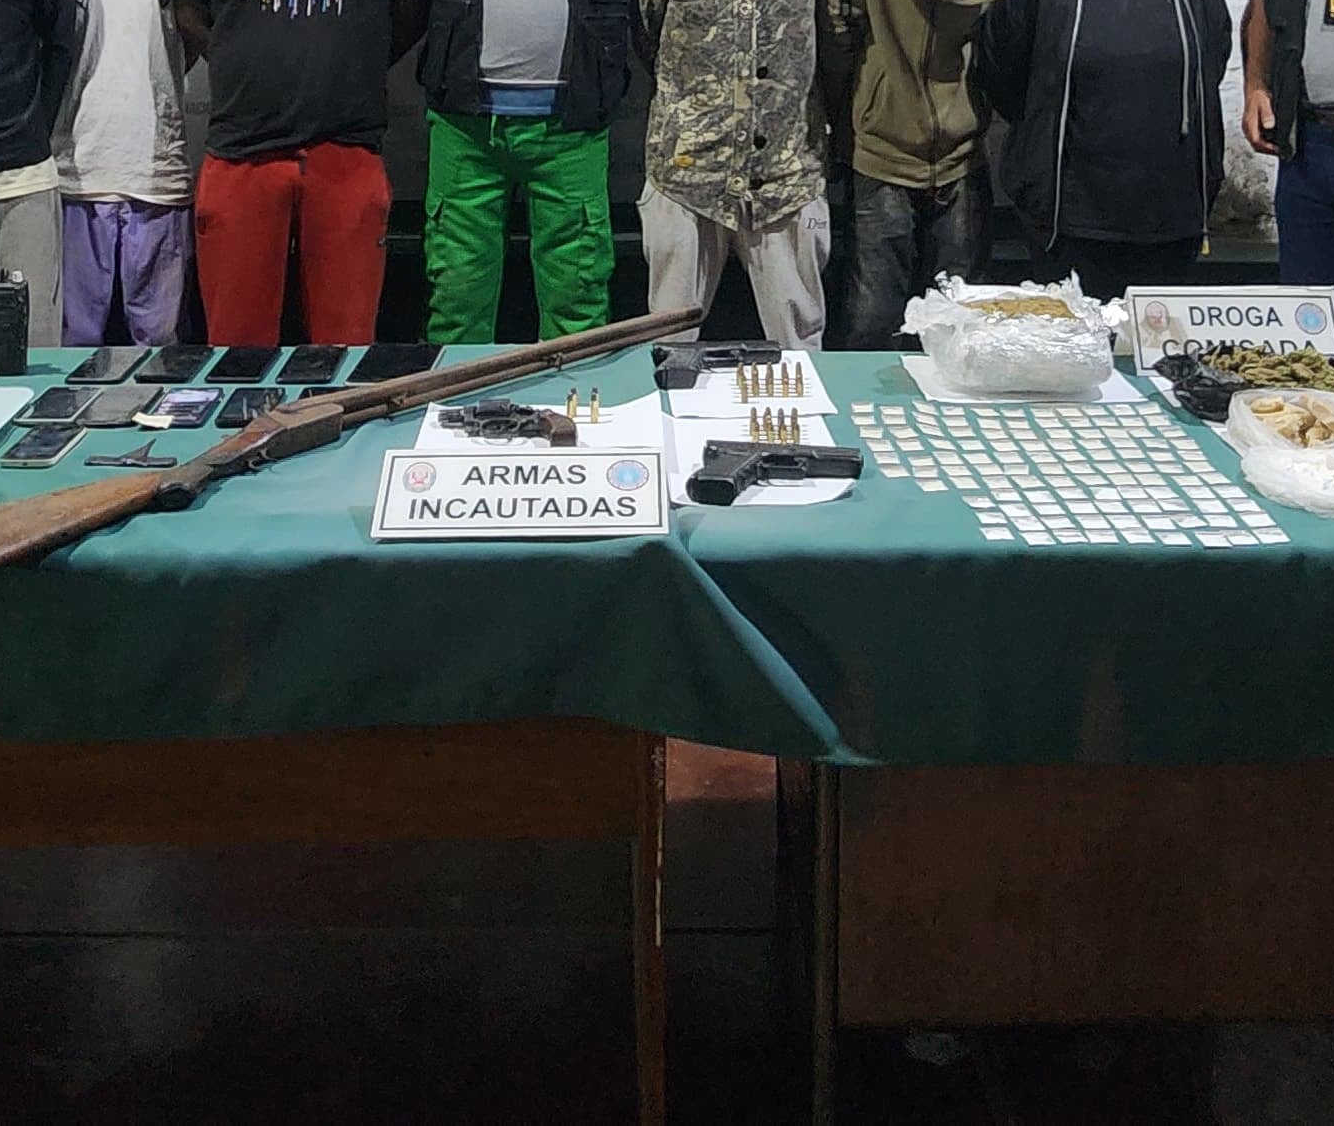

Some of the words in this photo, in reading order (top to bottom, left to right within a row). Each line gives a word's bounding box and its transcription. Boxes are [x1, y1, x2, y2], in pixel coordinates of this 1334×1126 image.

[1187, 305, 1284, 328] DROGA
[460, 464, 587, 486] ARMAS
[408, 496, 638, 520] INCAUTADAS
